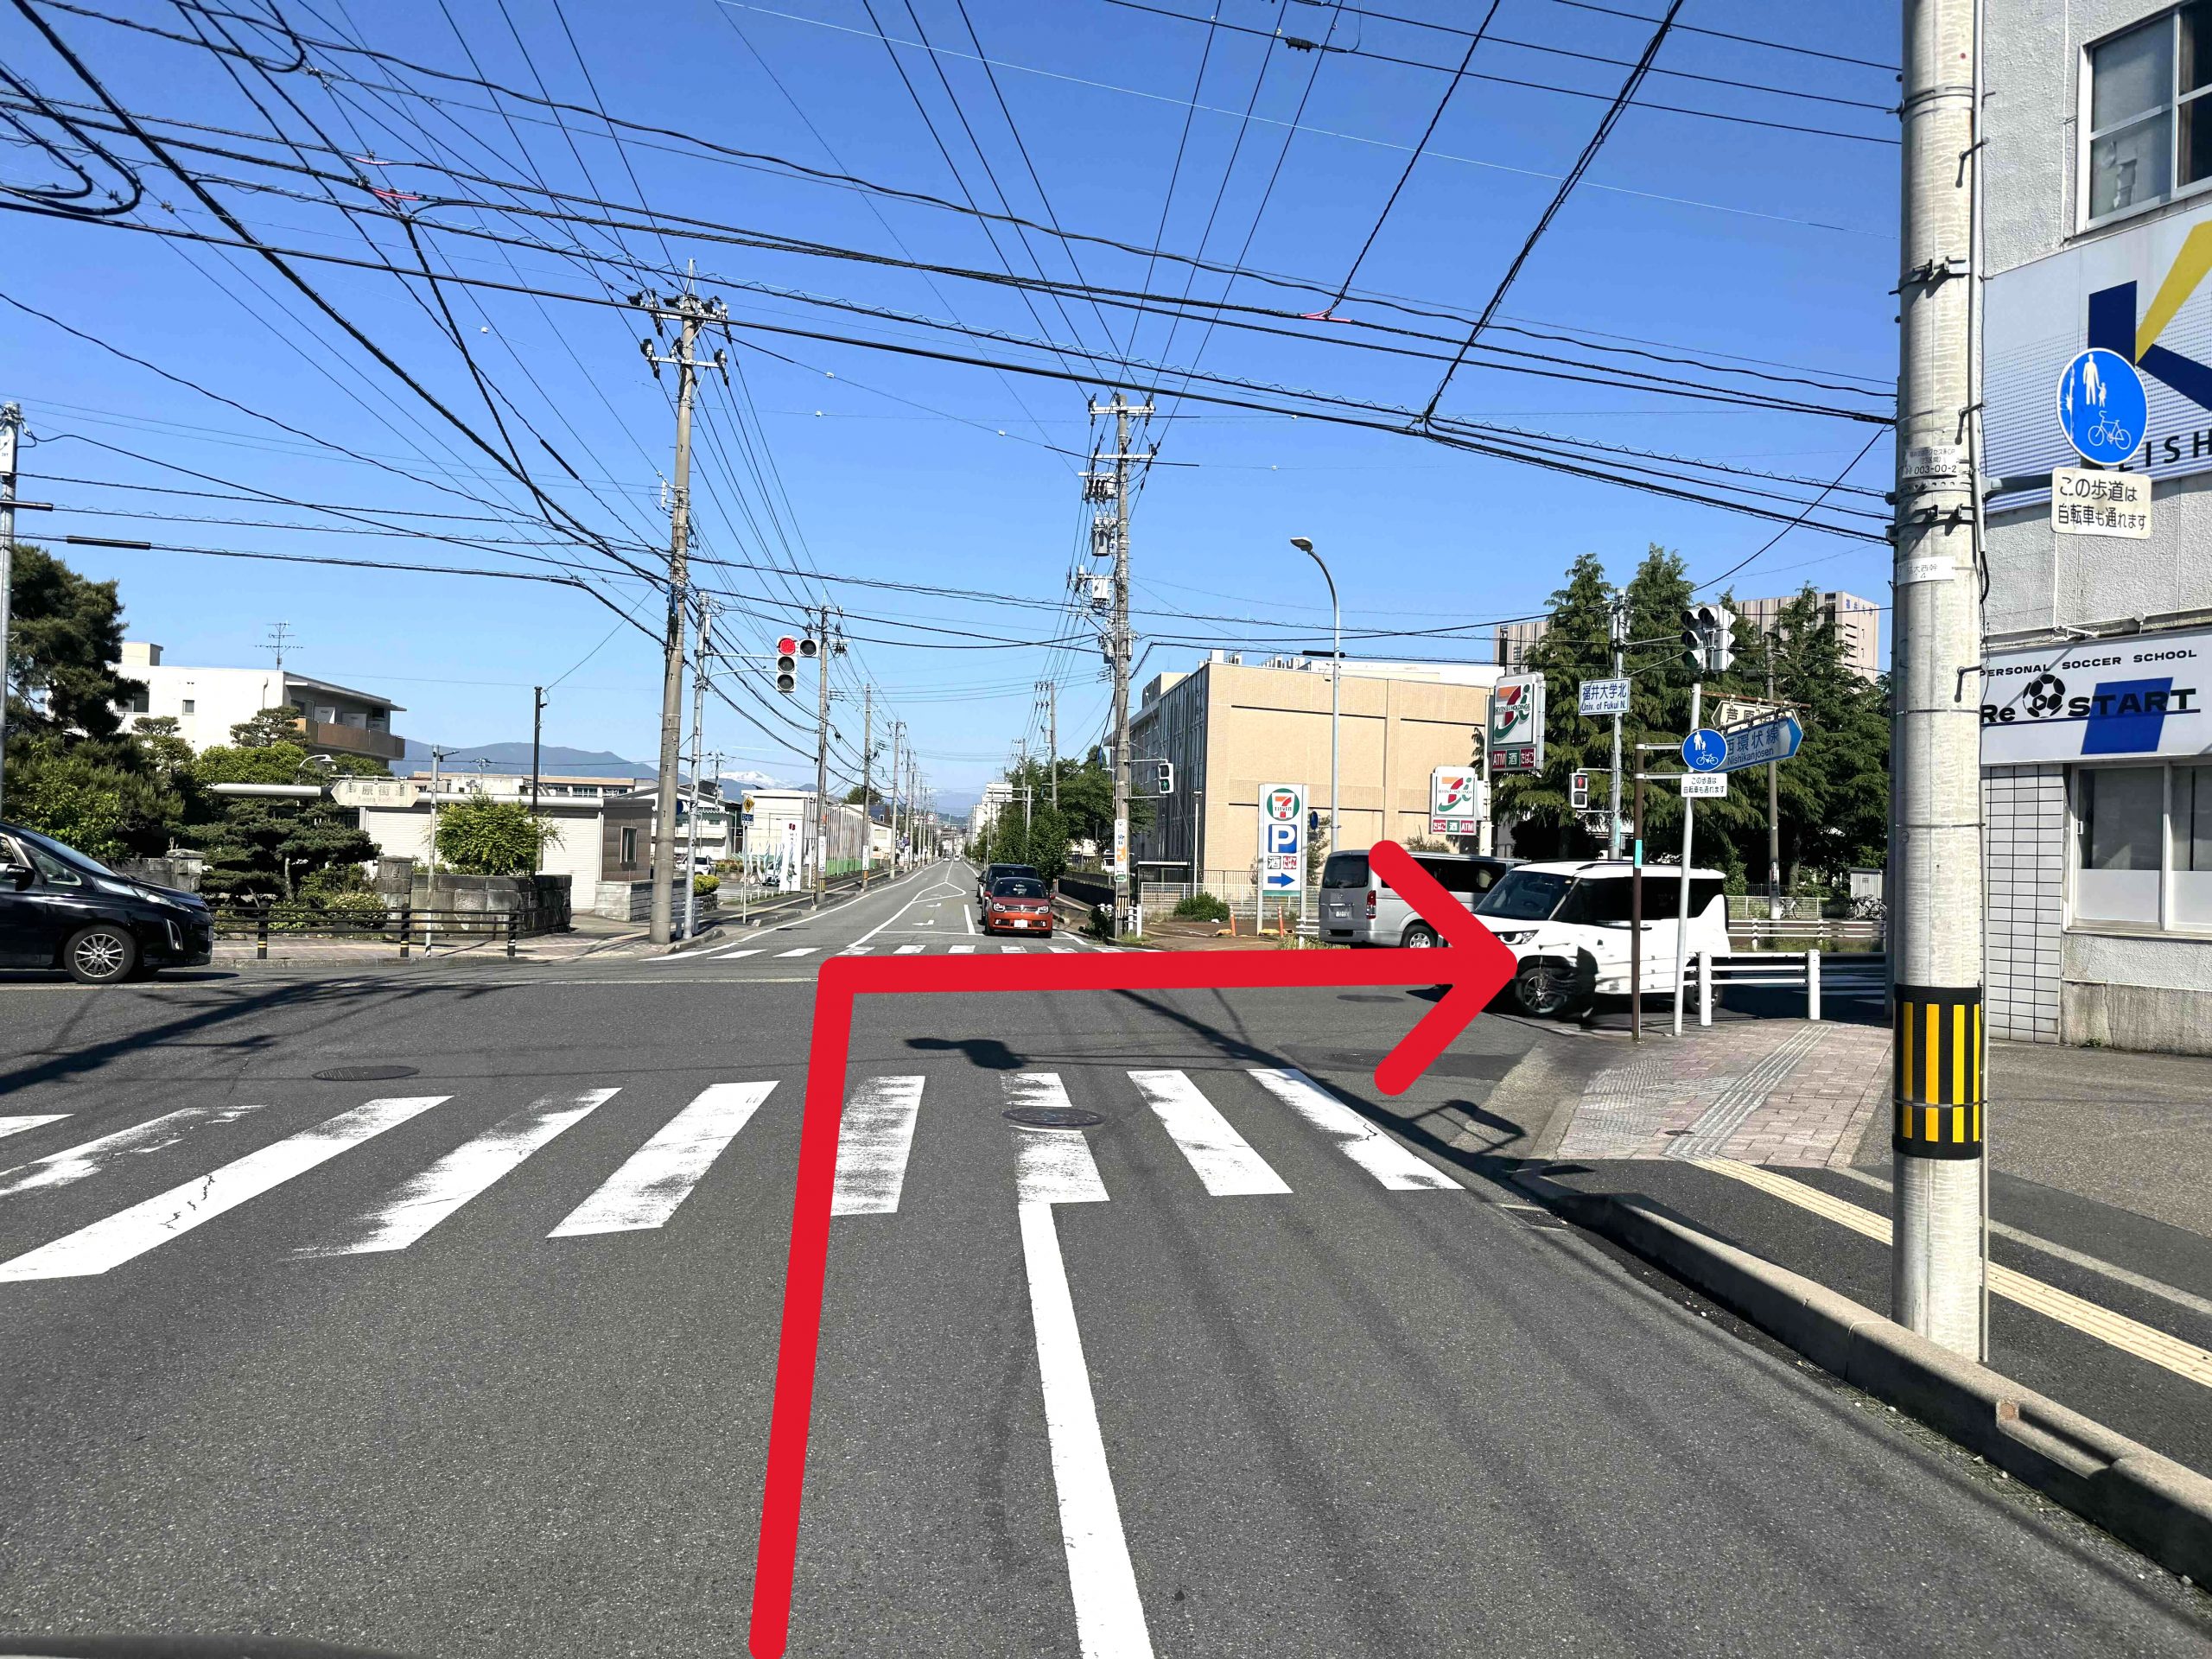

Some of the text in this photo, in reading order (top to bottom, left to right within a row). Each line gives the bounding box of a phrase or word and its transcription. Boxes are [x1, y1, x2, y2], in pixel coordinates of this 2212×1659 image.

[2060, 477, 2138, 502] この歩道は
[2058, 503, 2147, 531] 自転車も通れます
[1980, 649, 2197, 678] PERSONAL SOCCER SCHOOL
[1582, 683, 1627, 701] 福井大学北
[1581, 702, 1595, 711] Univ.
[1604, 701, 1619, 709] Fukui
[1980, 688, 2196, 723] Re START
[1726, 725, 1780, 756] 西環状線
[1493, 753, 1506, 766] ATM
[1508, 753, 1518, 766] 酒
[1521, 752, 1535, 765] たばこ
[1728, 748, 1774, 766] Nishikanjosen
[1461, 823, 1474, 832] ATM
[1272, 825, 1296, 853] P
